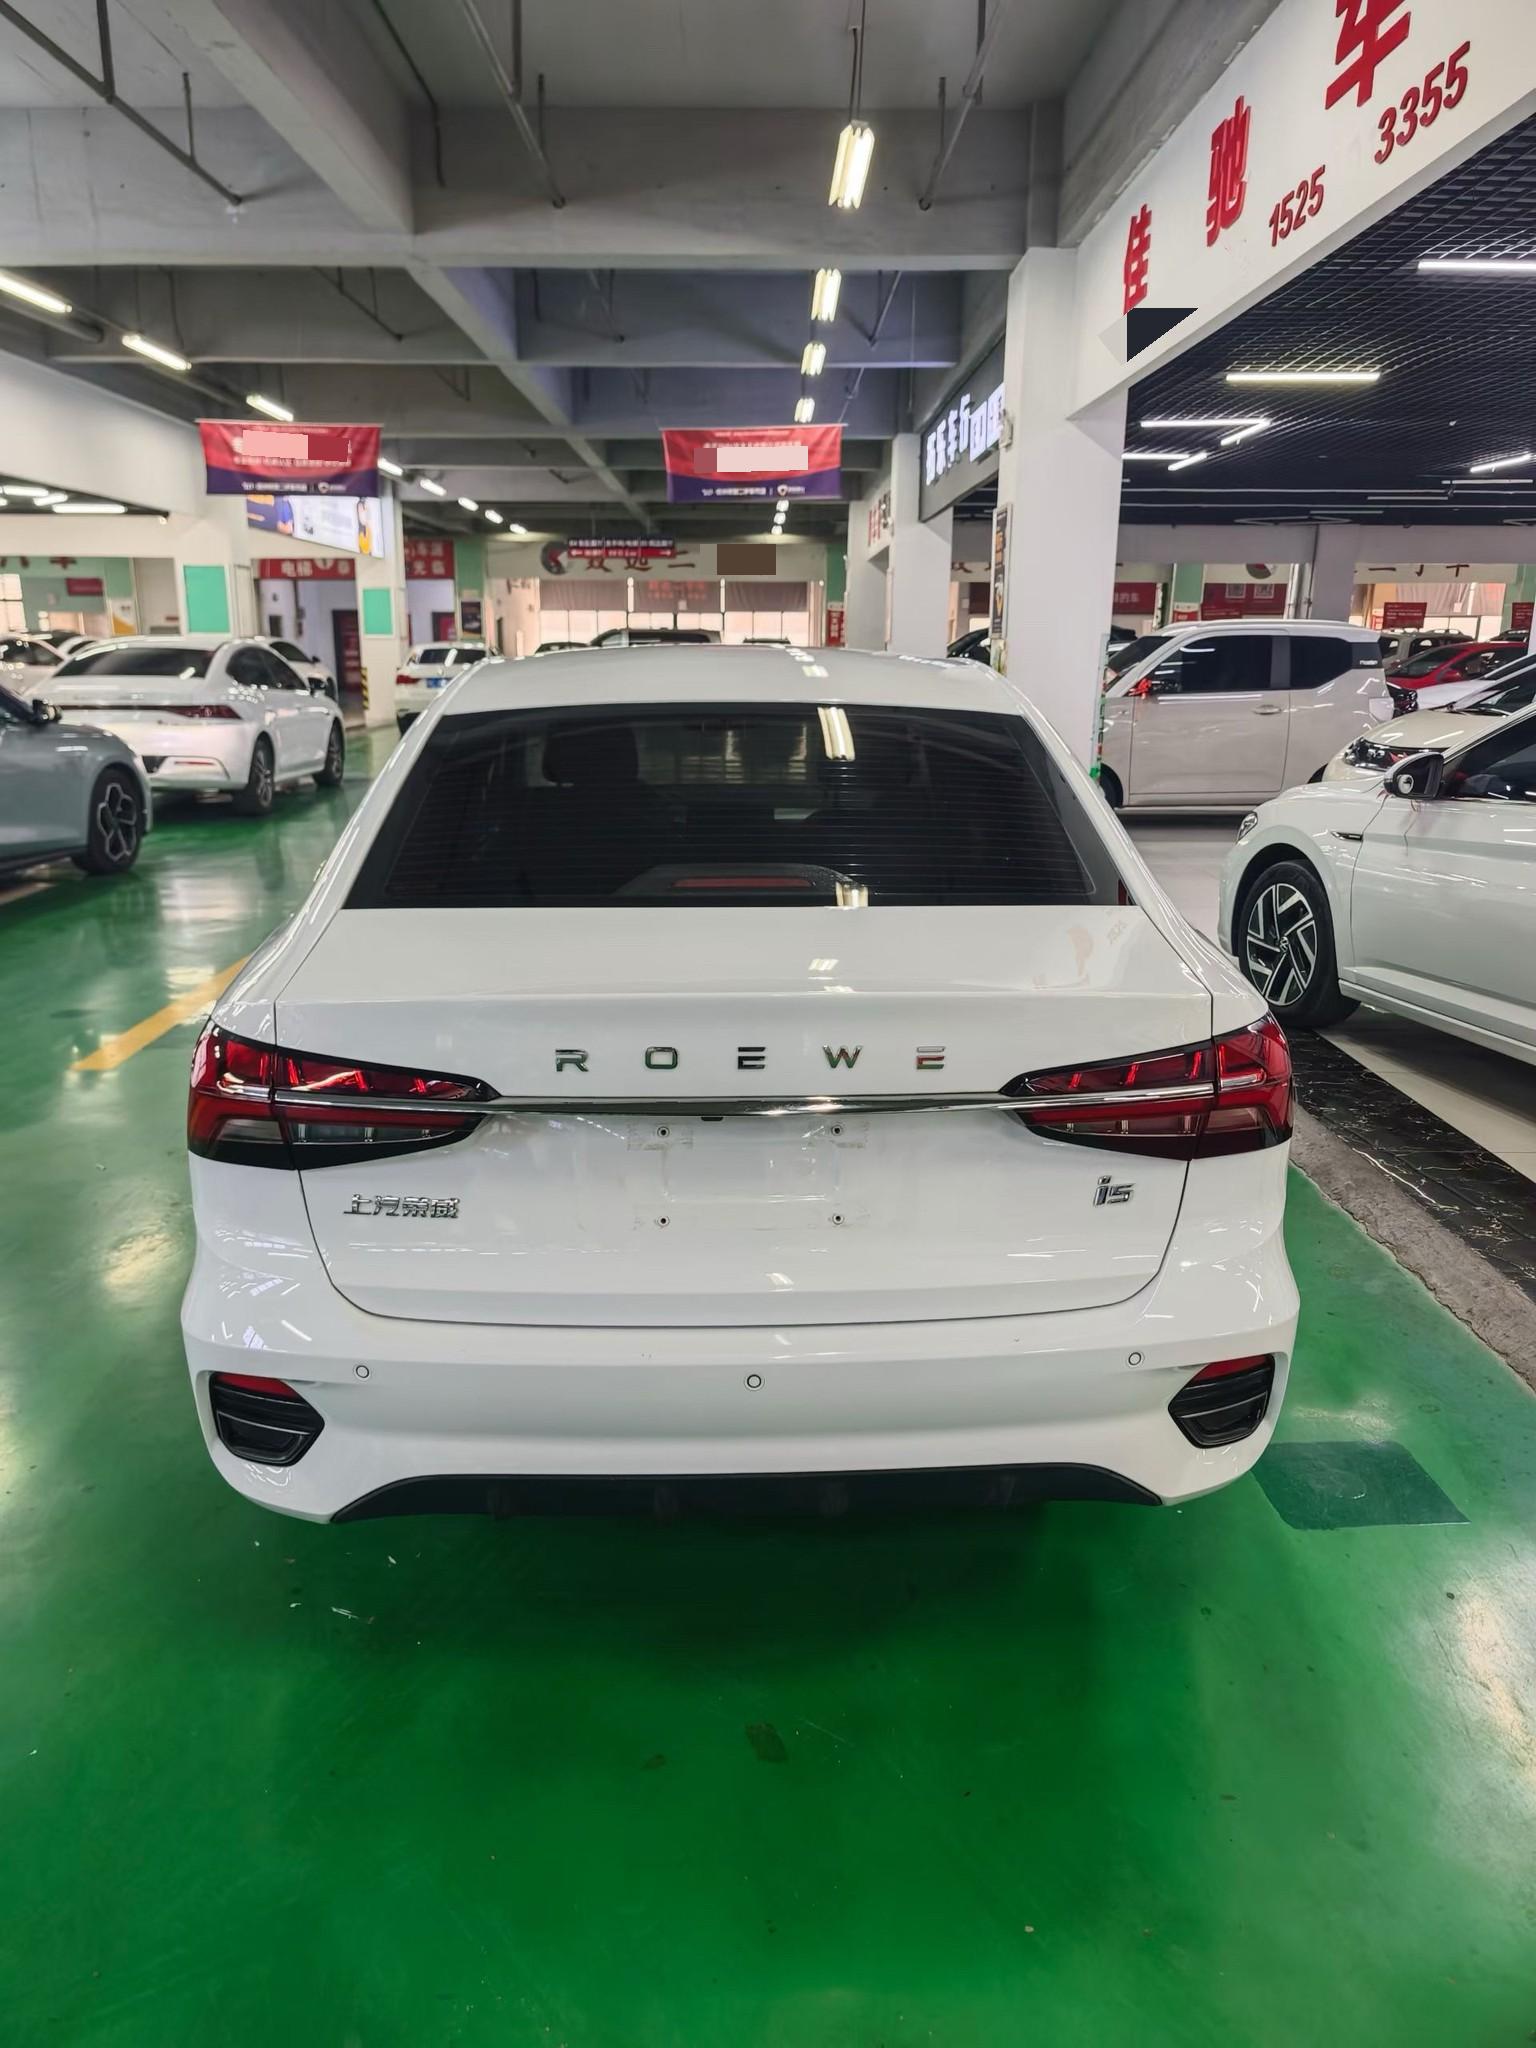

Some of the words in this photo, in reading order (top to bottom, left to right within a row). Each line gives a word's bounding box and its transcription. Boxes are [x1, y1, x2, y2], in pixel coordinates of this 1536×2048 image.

[1269, 164, 1326, 247] 1525
[1374, 41, 1471, 164] 3355
[555, 1045, 947, 1073] ROEWE
[343, 1193, 460, 1219] 上汽荣威
